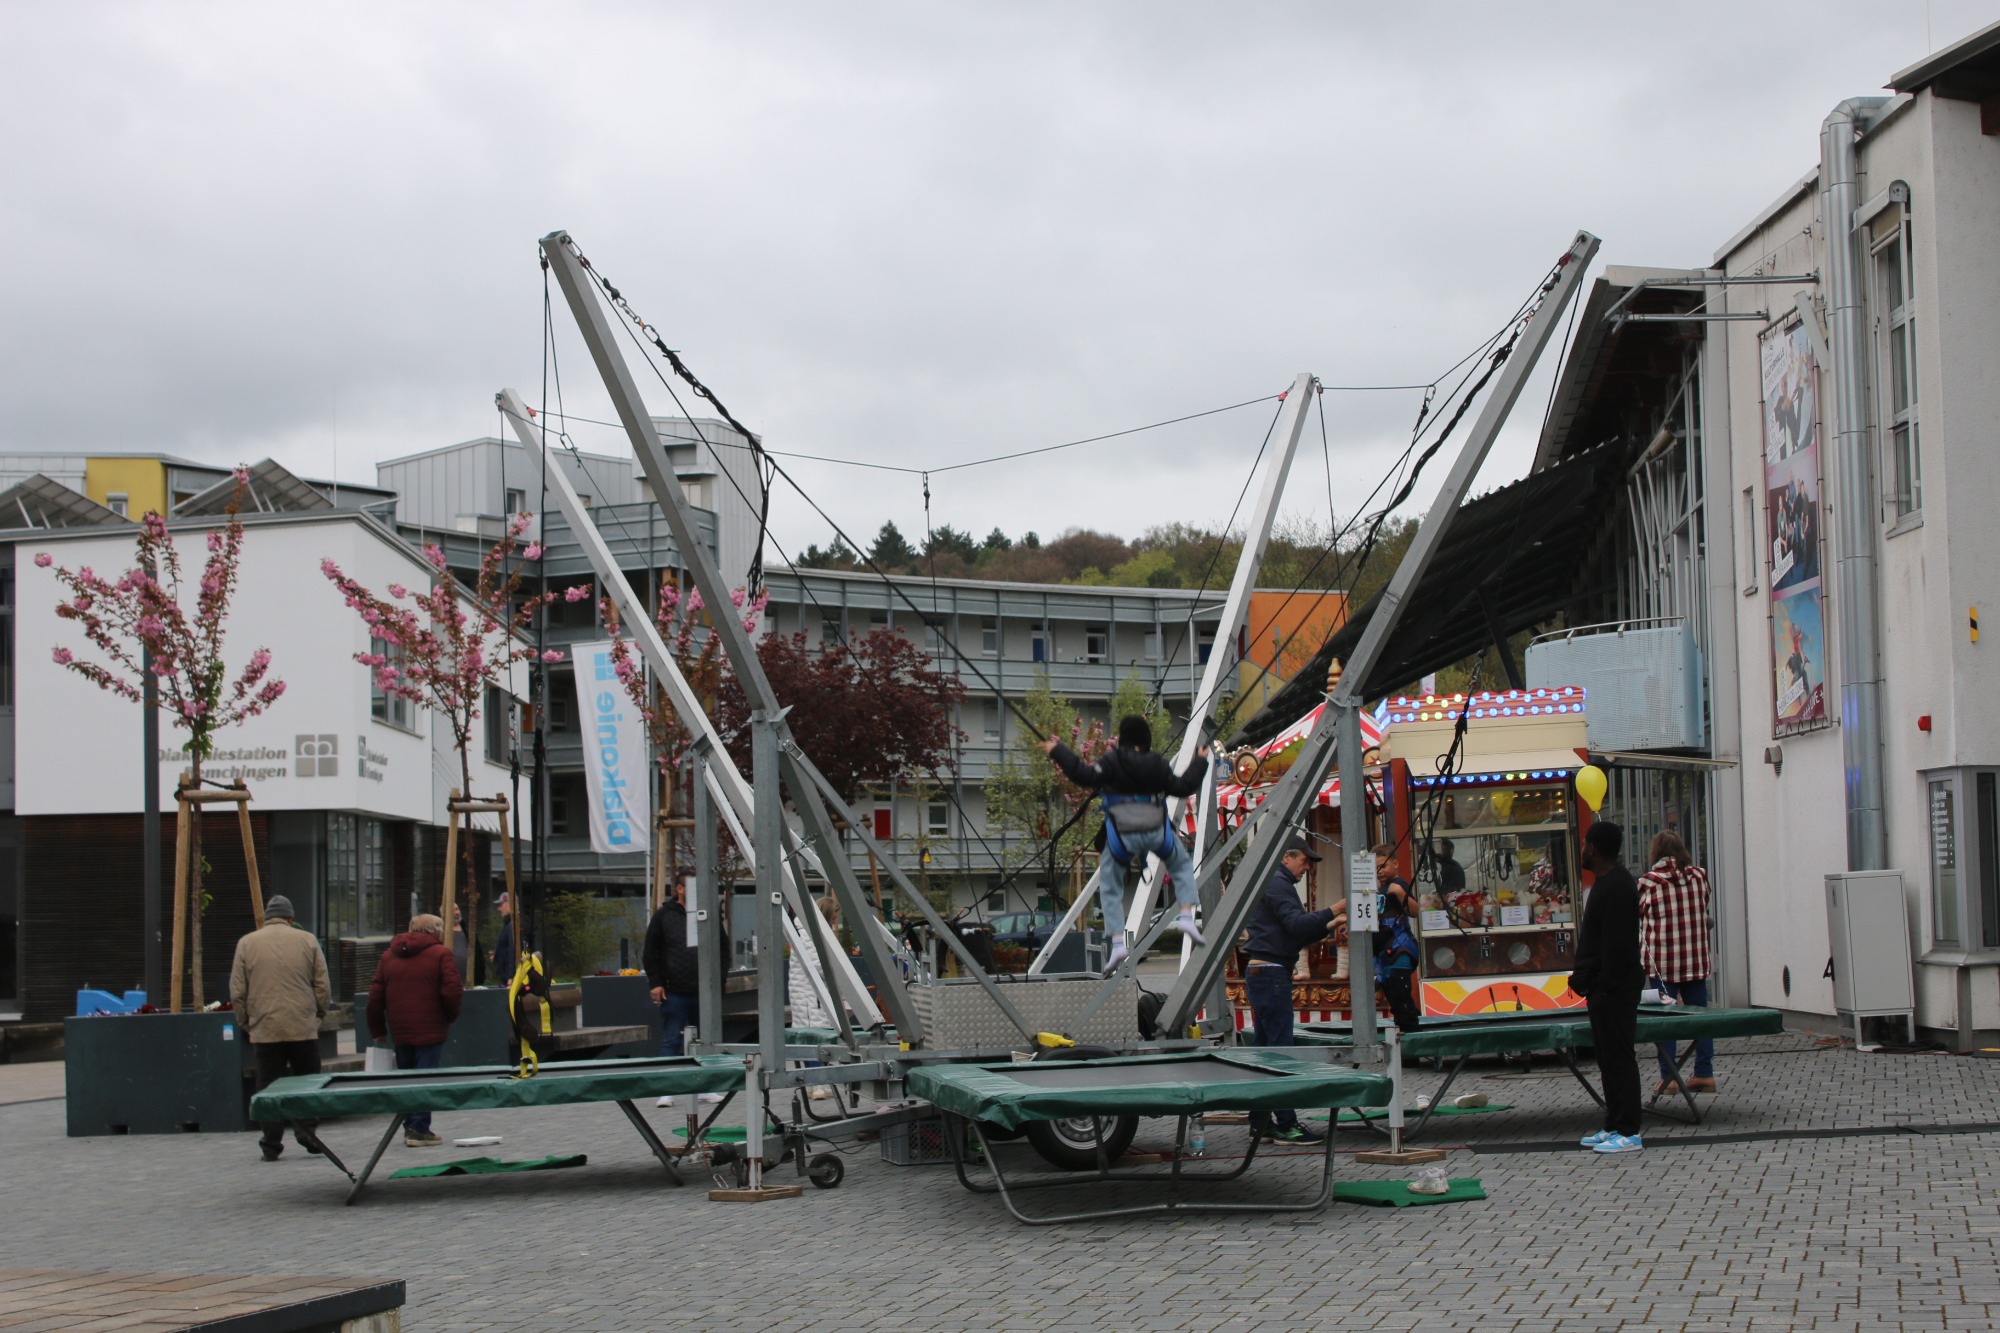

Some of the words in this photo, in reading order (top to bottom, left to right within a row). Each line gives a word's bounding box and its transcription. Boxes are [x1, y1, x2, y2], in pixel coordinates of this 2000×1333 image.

[159, 746, 287, 761] Diakiestation
[1357, 903, 1363, 919] 5
[1365, 903, 1371, 919] €
